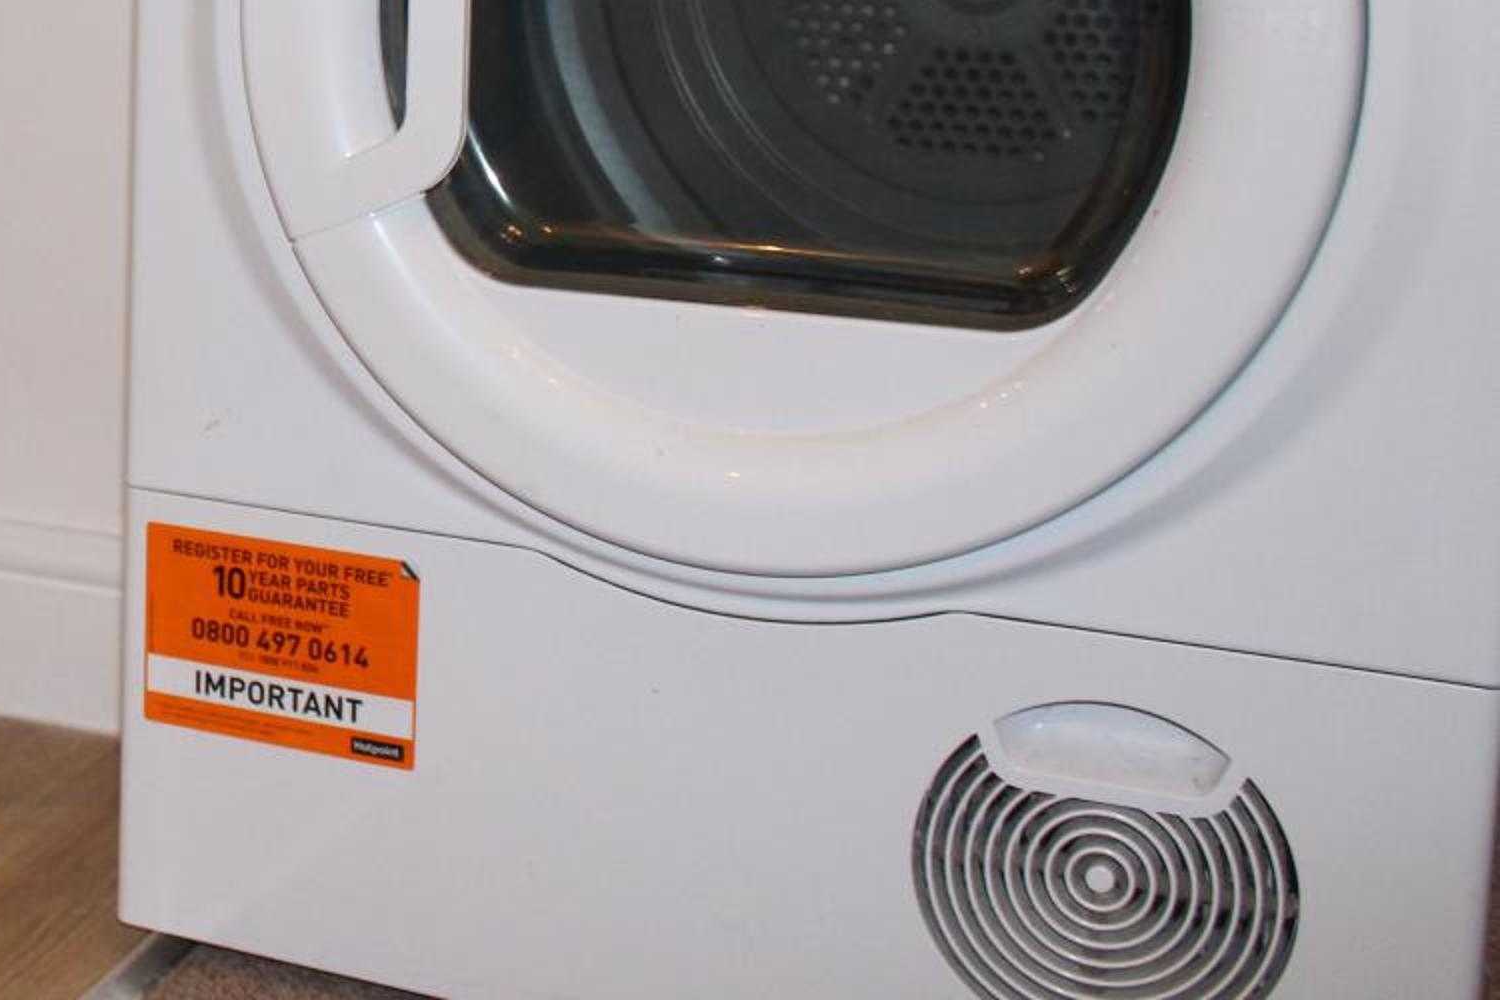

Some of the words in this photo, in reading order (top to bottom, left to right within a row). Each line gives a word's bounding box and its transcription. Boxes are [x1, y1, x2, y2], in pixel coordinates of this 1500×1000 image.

[172, 538, 253, 564] REGISTER
[256, 551, 289, 570] FOR
[293, 558, 340, 581] YOUR
[212, 565, 247, 600] 10
[249, 570, 291, 590] YEAR
[296, 577, 351, 601] PARTS
[228, 608, 258, 624] CALL
[261, 613, 292, 630] FREE
[247, 587, 351, 618] GUARANTEE
[191, 616, 250, 648] 0800
[255, 629, 301, 656] 497
[307, 637, 370, 669] 0614
[194, 669, 364, 724] IMPORTANT
